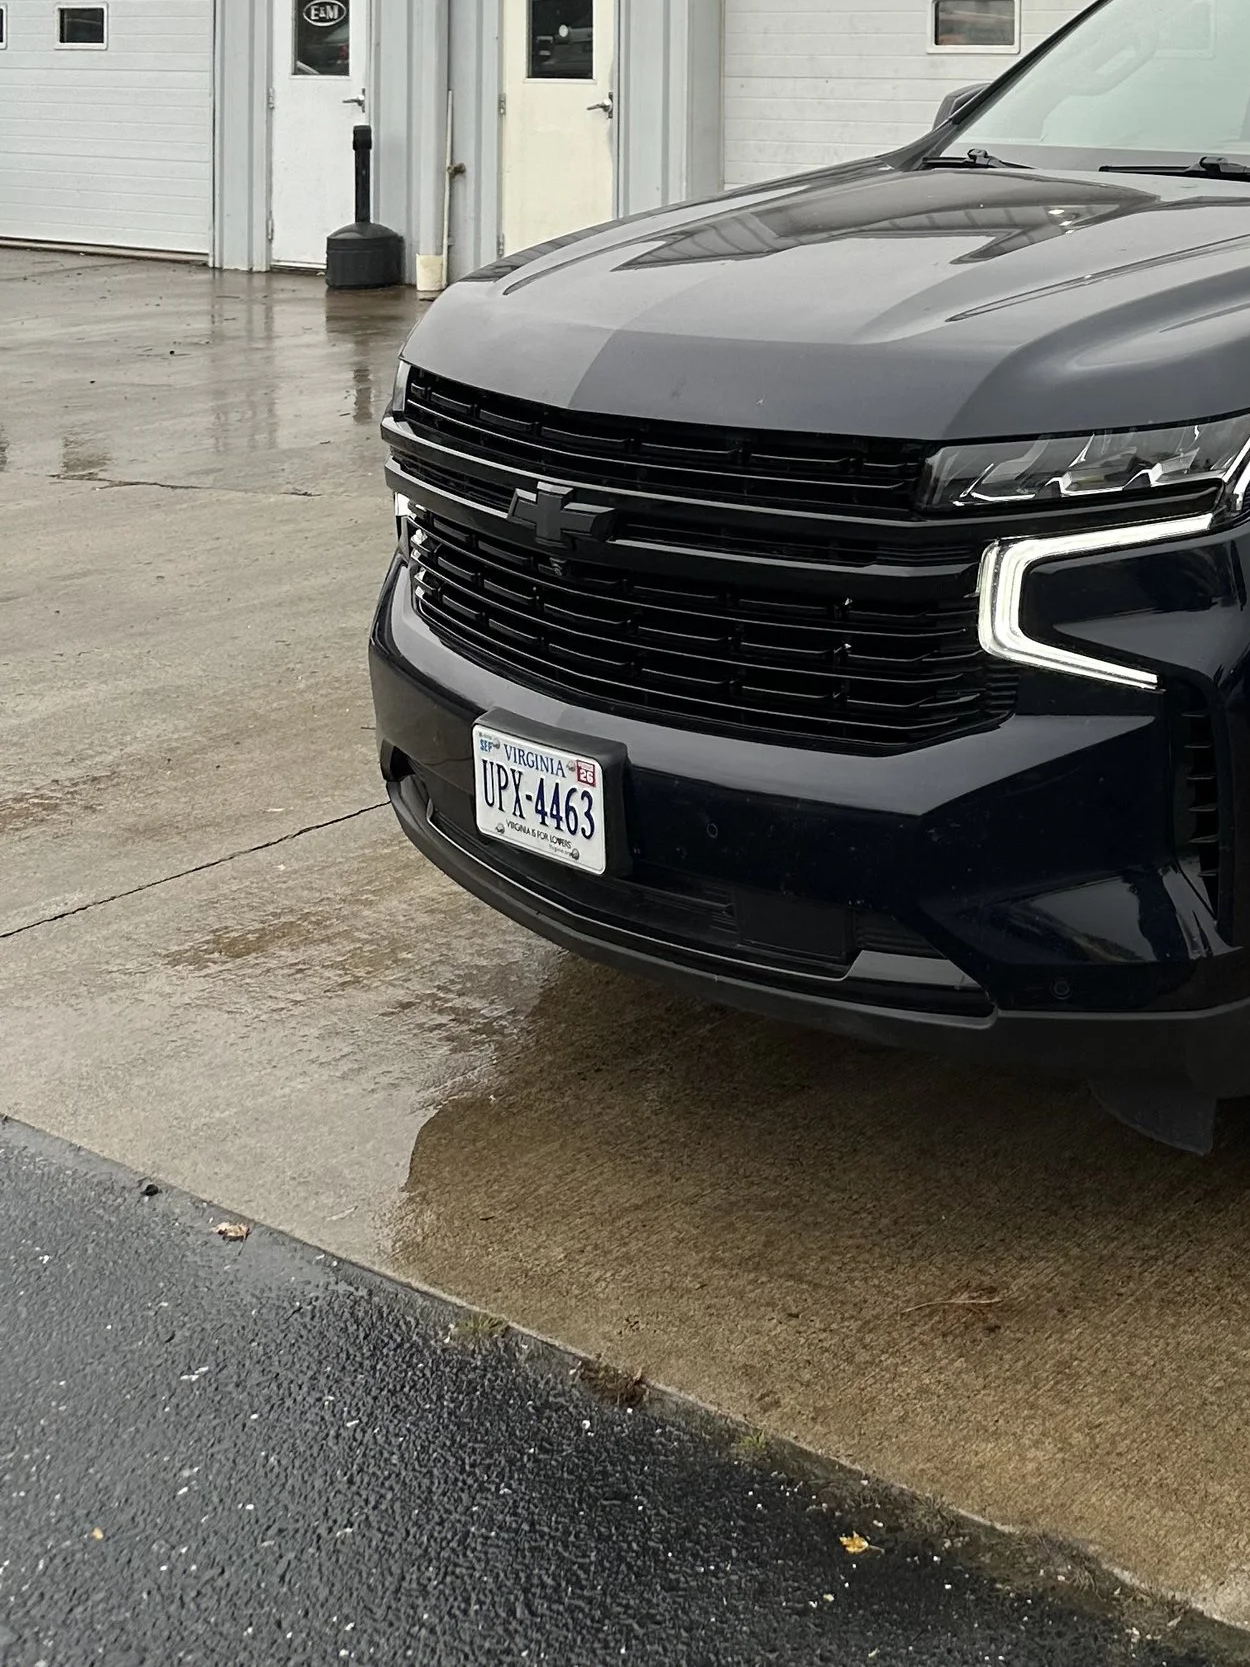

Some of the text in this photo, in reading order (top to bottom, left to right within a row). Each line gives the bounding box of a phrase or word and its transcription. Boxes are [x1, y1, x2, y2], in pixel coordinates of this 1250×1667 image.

[310, 5, 339, 20] E&M
[503, 743, 567, 778] VIRGINIA
[579, 769, 594, 784] 26
[482, 758, 595, 840] UPX-4463
[506, 819, 531, 835] VIRGINIA
[537, 830, 549, 841] FOR
